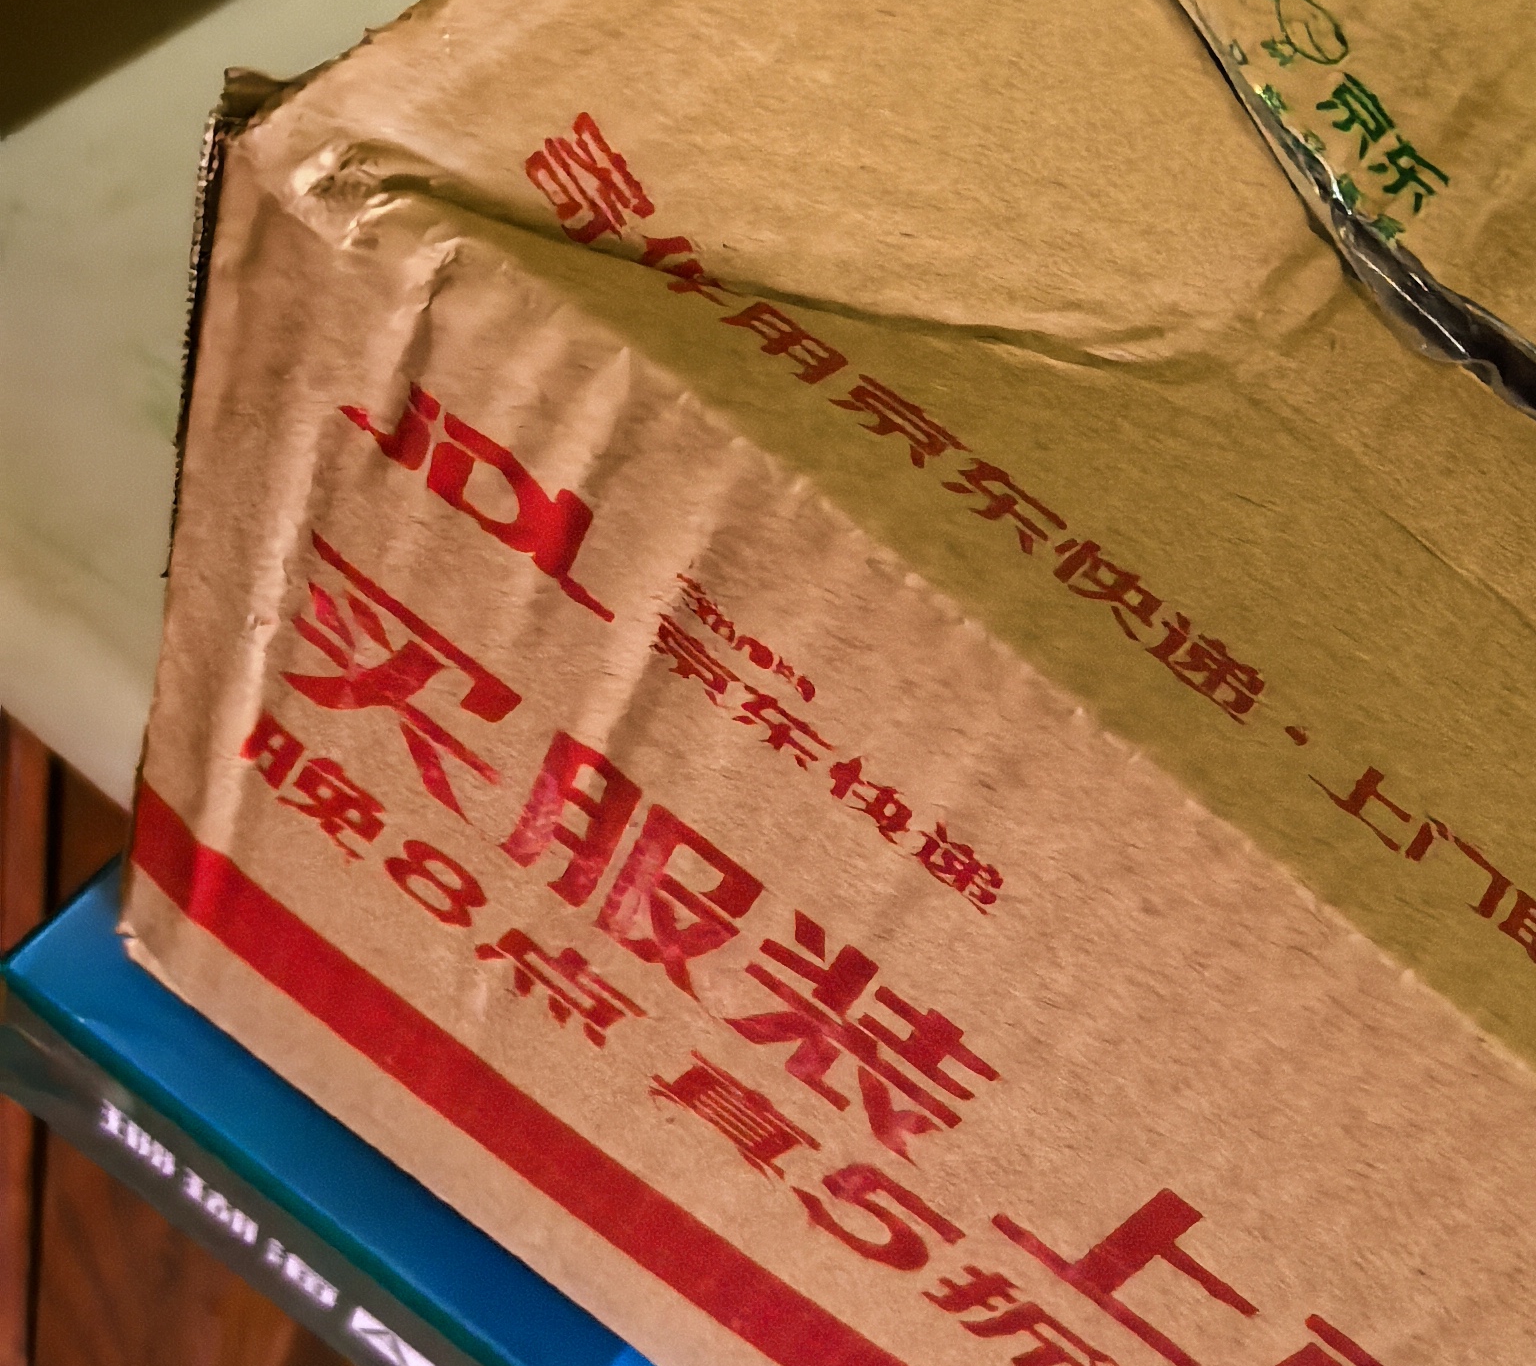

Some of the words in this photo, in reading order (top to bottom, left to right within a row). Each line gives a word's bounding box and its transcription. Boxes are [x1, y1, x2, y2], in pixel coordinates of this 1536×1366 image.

[1316, 71, 1450, 214] 京东
[338, 382, 614, 623] JDL
[650, 613, 1004, 915] 京东快递
